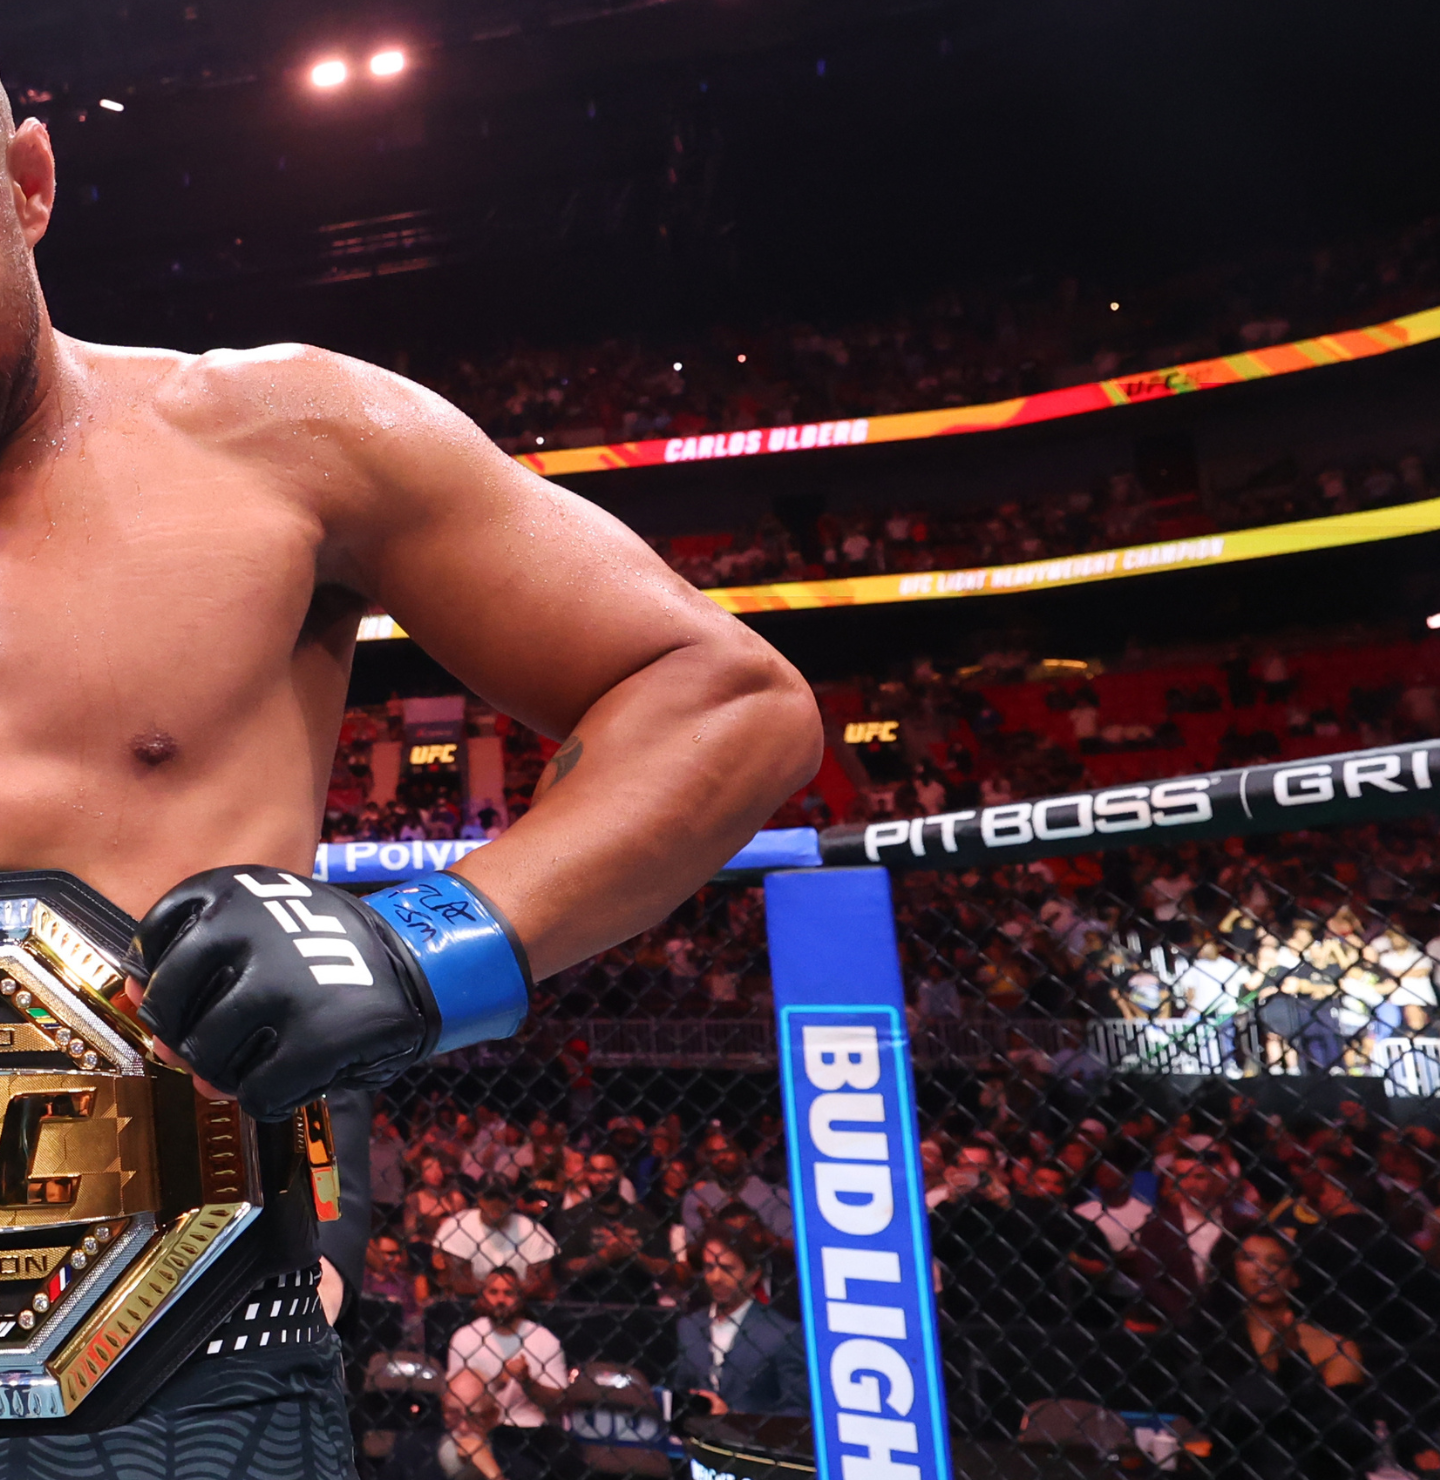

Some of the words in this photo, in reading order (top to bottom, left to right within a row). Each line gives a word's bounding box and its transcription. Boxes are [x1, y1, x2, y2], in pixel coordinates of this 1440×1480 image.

[664, 430, 762, 463] CARLOS
[767, 418, 869, 452] ULBERG
[899, 574, 932, 596] UFC
[936, 569, 987, 592] LIGHT
[990, 552, 1118, 588] HEAVYWEIGHT
[1122, 537, 1224, 570] CHAMPION
[409, 744, 458, 765] UFC
[843, 721, 899, 744] UFC
[863, 811, 976, 862] PIT
[980, 780, 1212, 848] BOSS
[1273, 750, 1433, 807] GRI
[234, 873, 374, 986] UFC
[802, 1025, 895, 1237] BUD
[820, 1246, 922, 1480] LIGH
